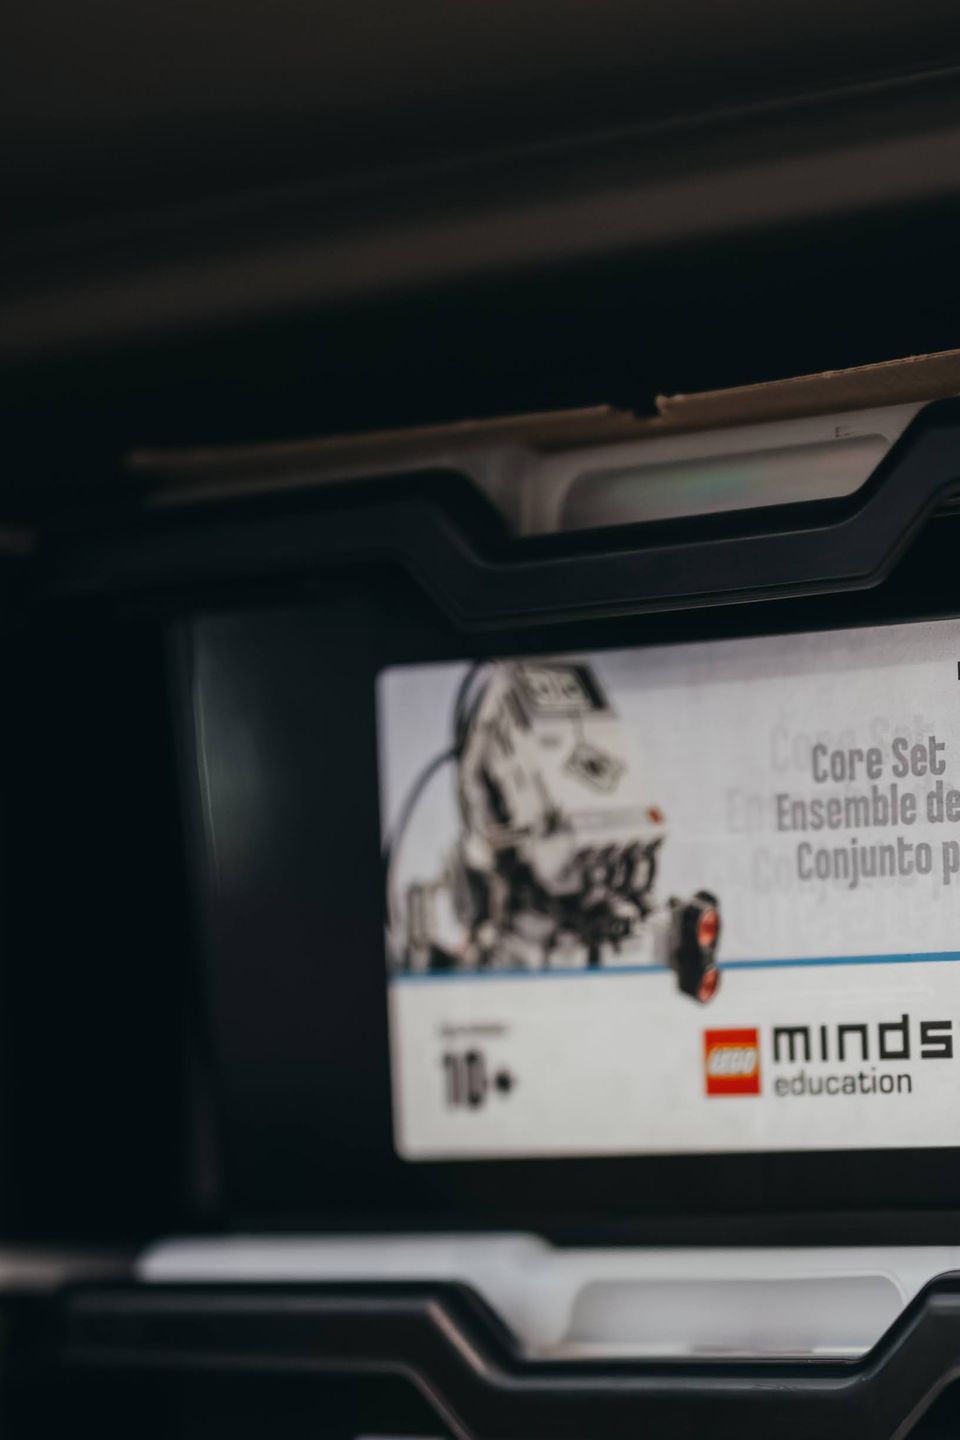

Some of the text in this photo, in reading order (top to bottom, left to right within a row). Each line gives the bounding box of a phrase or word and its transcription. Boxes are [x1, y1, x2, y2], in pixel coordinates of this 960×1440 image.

[810, 735, 947, 784] Core Set
[776, 782, 917, 832] Ensemble
[797, 837, 932, 890] Conjunto
[773, 1068, 913, 1097] education
